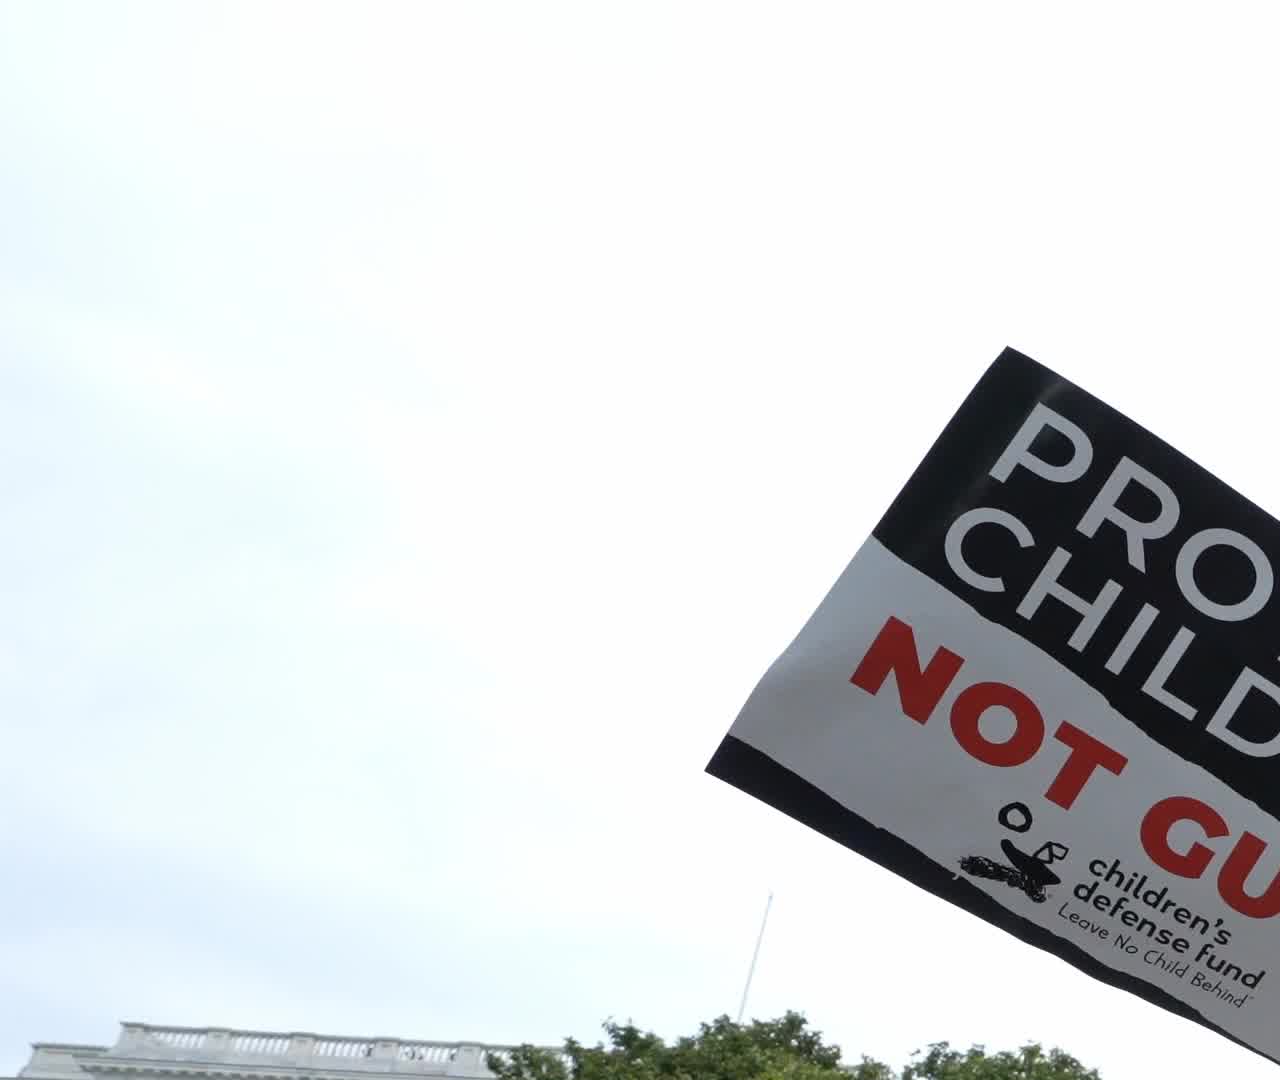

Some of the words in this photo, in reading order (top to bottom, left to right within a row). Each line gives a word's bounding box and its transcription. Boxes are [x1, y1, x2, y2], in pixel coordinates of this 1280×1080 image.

[850, 615, 1128, 812] NOT
[1058, 902, 1110, 940] Leave
[1114, 934, 1138, 954] No
[1143, 950, 1190, 978] Child
[1190, 972, 1248, 1008] Behind
[1073, 881, 1190, 954] defense
[1194, 943, 1266, 989] fund
[1089, 859, 1231, 945] children's
